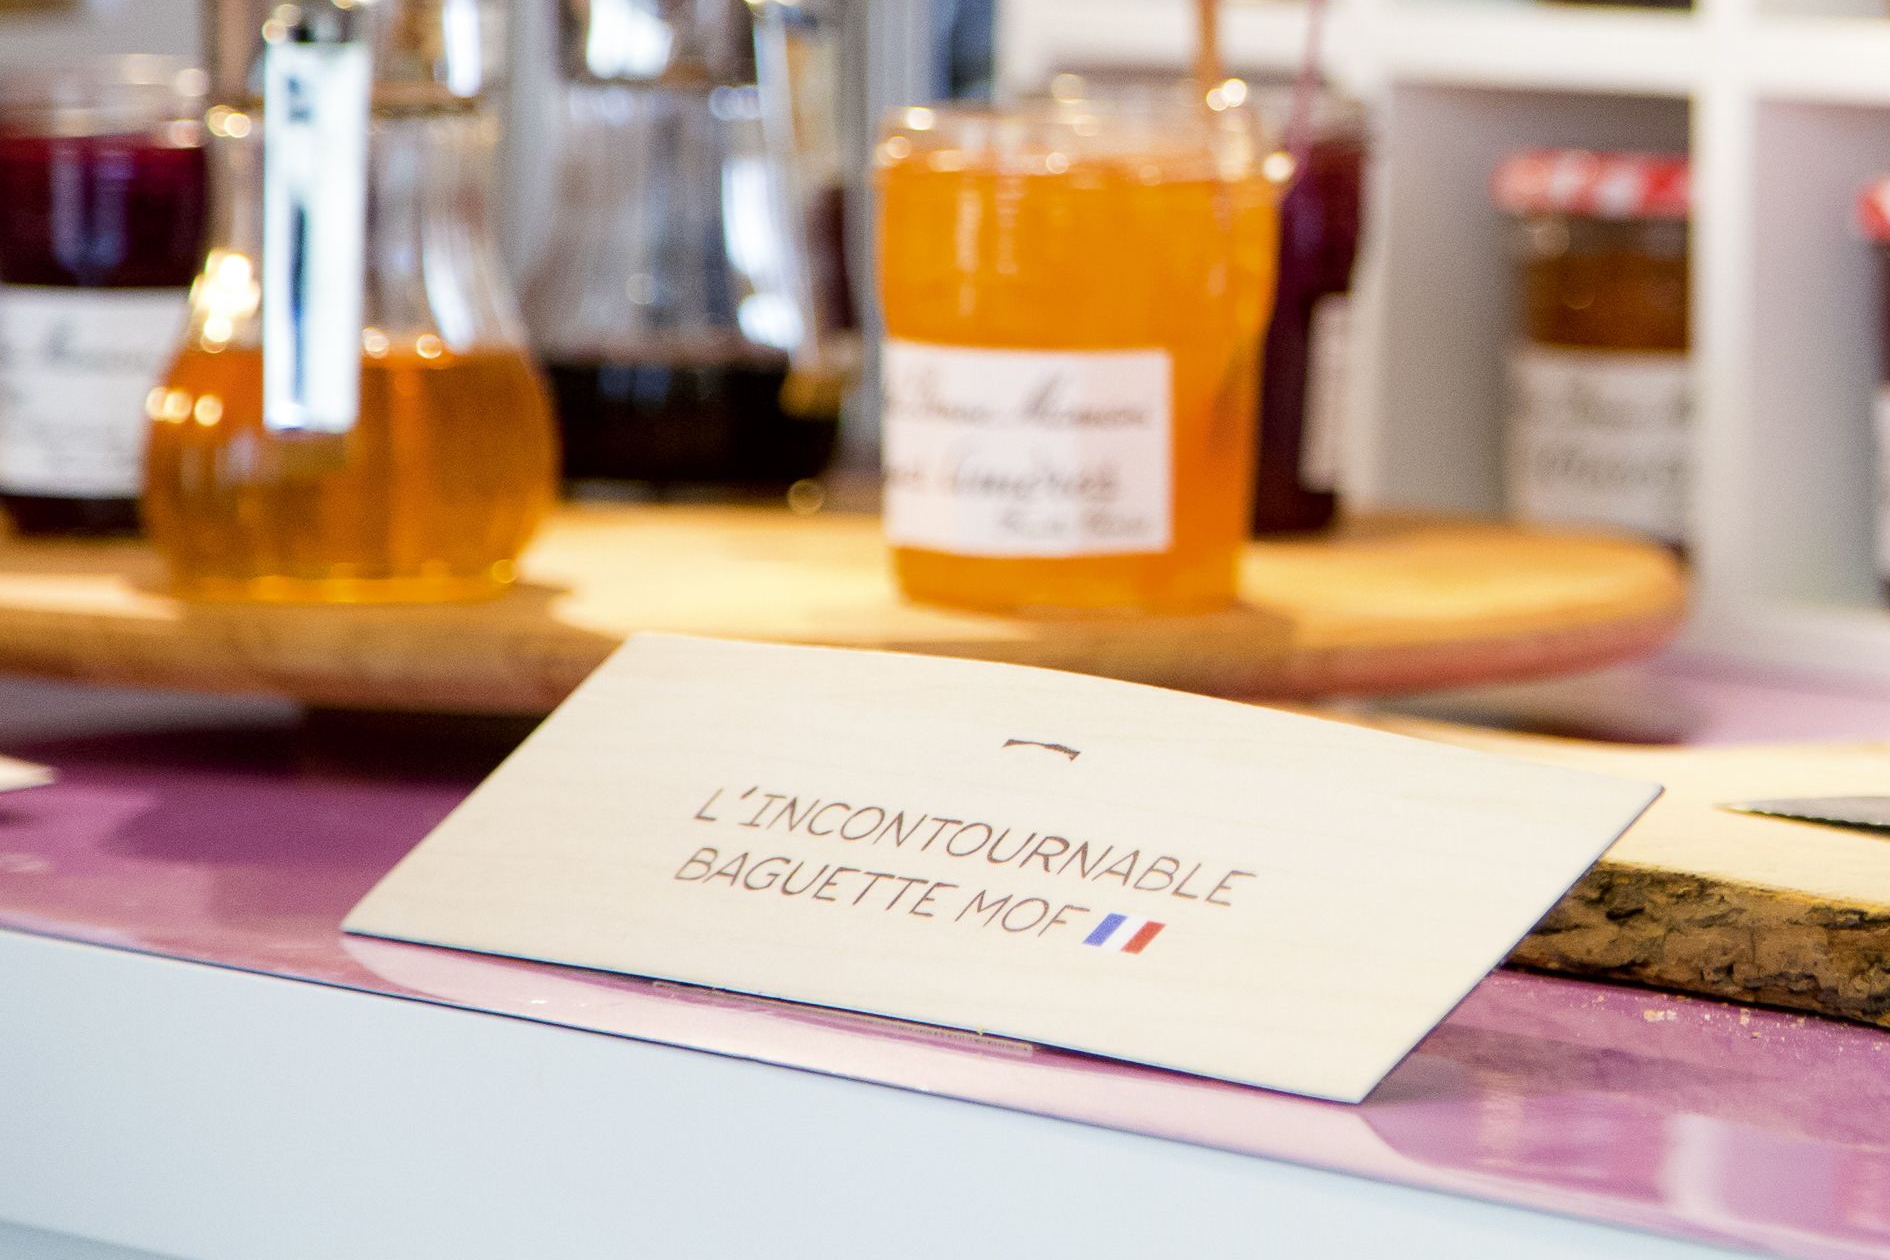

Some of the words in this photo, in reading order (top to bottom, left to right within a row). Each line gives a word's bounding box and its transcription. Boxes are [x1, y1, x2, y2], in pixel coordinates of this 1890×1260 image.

[673, 846, 960, 918] BAGUETTE
[955, 889, 1091, 938] MOF
[693, 785, 1258, 908] L'INCONTOURNABLE
